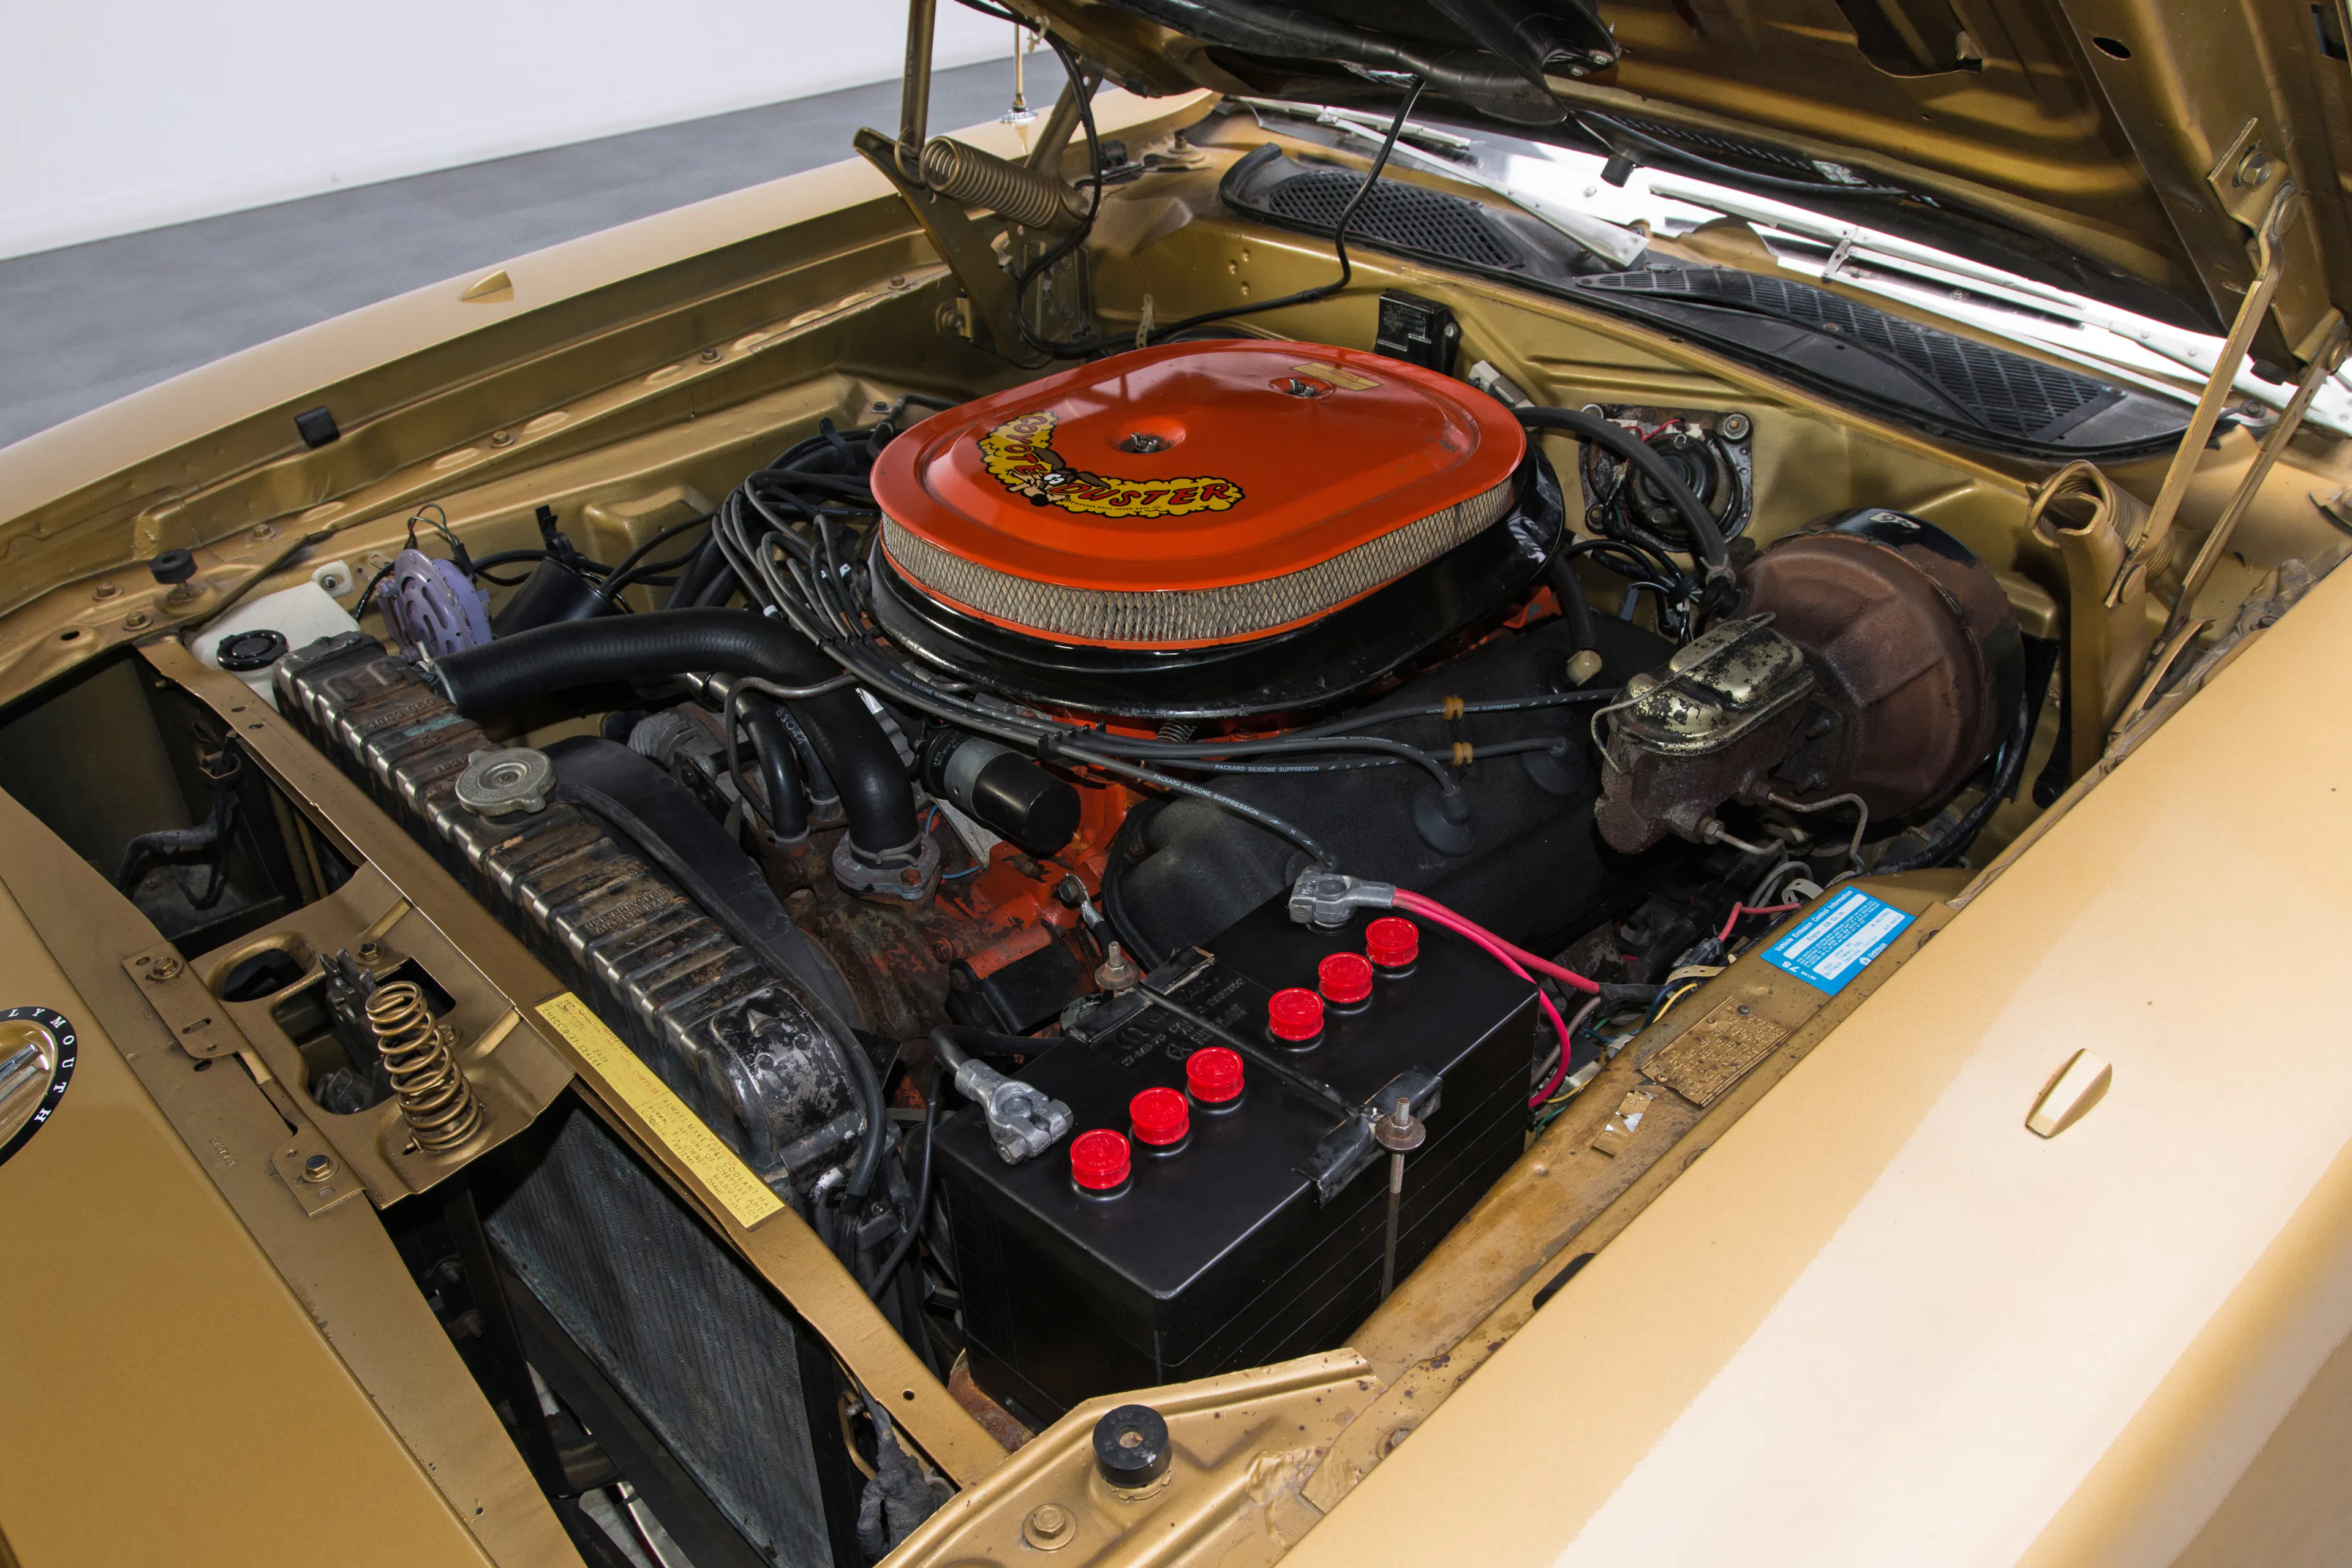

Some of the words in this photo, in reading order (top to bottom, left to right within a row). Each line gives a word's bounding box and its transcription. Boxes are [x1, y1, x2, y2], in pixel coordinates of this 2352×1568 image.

[1005, 415, 1049, 475] COYOTE
[1047, 483, 1231, 507] DUSTER
[889, 670, 911, 685] PACKARD
[911, 681, 933, 695] SILICONE
[934, 692, 968, 708] SUPPRESSION
[1153, 774, 1181, 786] PACKARD
[1183, 783, 1212, 797] SILICONE
[1213, 794, 1259, 816] SUPPRESSION
[584, 913, 607, 930] USE
[610, 888, 668, 918] CHRYSLER
[1773, 937, 1794, 952] Vehicle
[1791, 921, 1814, 938] Emission
[1811, 908, 1830, 922] Control
[1826, 889, 1854, 909] Information
[1779, 959, 1801, 973] 78
[600, 1026, 633, 1057] IMPORTANT
[8, 1008, 75, 1123] LYMOUTH
[617, 1055, 634, 1068] WITH
[631, 1069, 660, 1095] CHRYSLER
[661, 1098, 688, 1123] ALWAYS
[685, 1123, 707, 1143] MAKE
[704, 1143, 725, 1161] SURE
[722, 1161, 759, 1195] COOLANT
[756, 1195, 775, 1212] HAS
[705, 1134, 739, 1167] WARNING
[703, 1153, 715, 1163] OF
[714, 1164, 748, 1196] CHRYSLER
[712, 1174, 743, 1203] MANUAL
[743, 1205, 760, 1220] FOR
